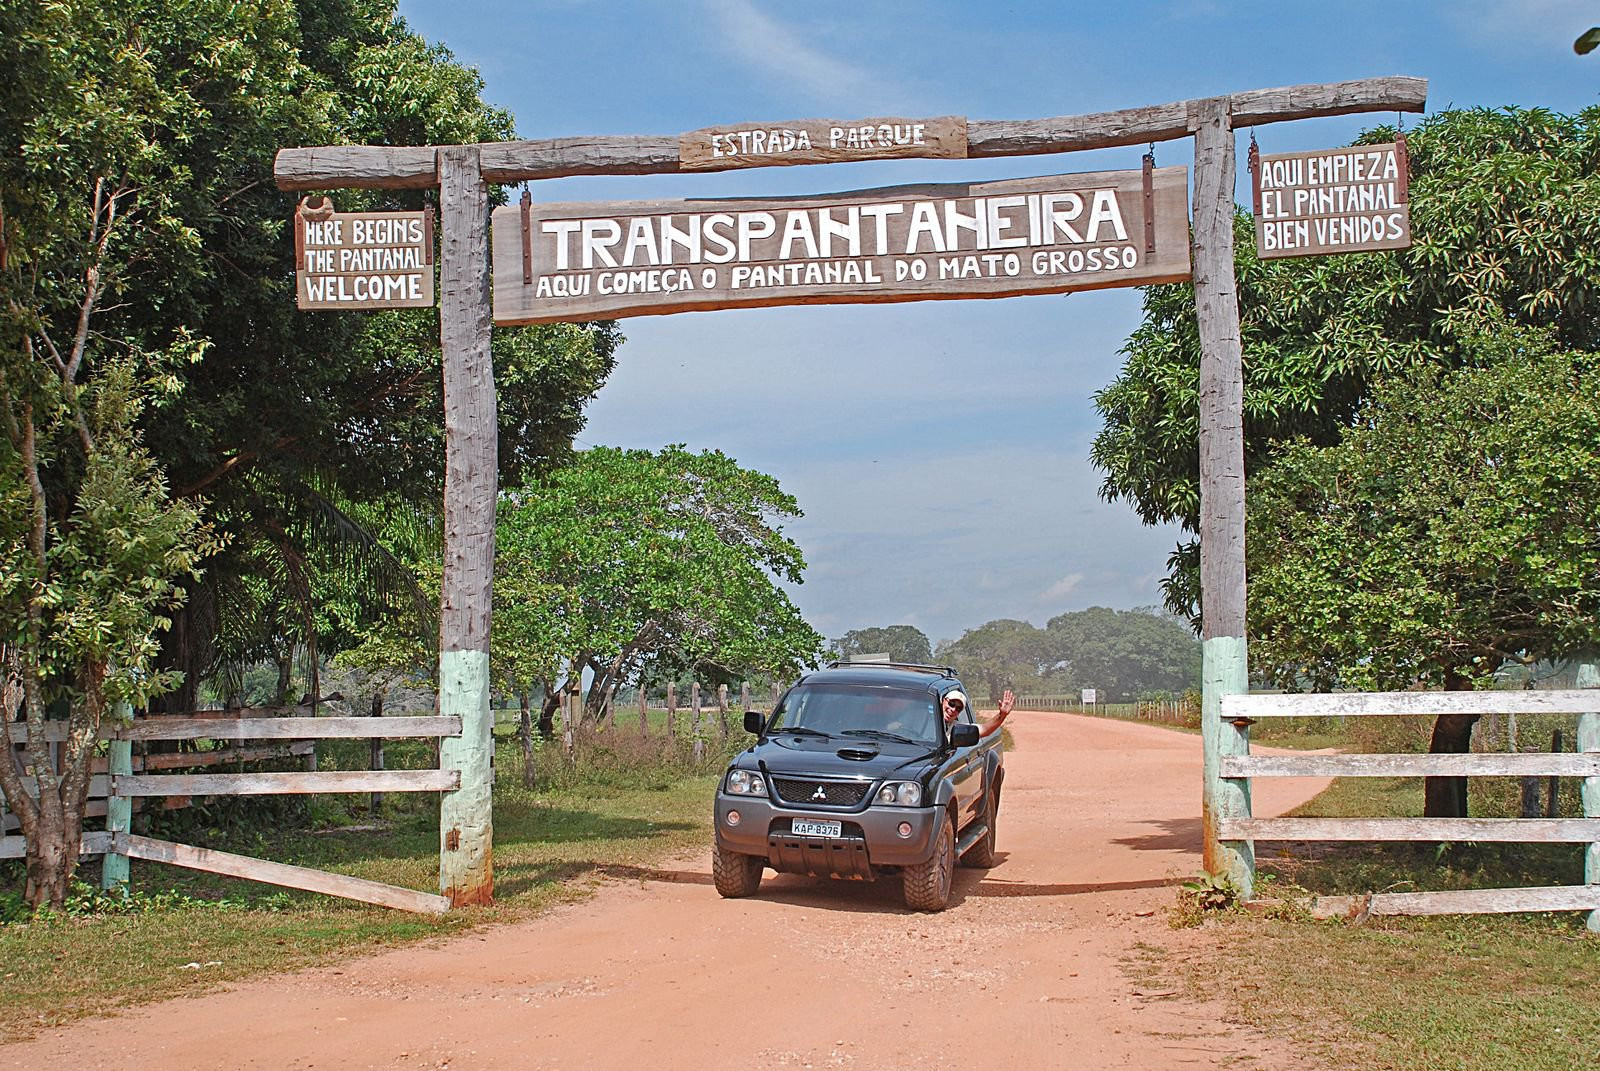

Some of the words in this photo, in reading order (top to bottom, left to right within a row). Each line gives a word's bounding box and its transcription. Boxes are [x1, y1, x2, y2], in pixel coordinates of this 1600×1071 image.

[711, 129, 812, 158] ESTRADA
[830, 123, 926, 149] PARQUE
[1261, 159, 1302, 188] AQUI
[1307, 151, 1398, 184] EMPIEZA
[1262, 190, 1290, 219] EL
[1295, 183, 1401, 216] PANTANAL
[305, 220, 343, 245] HERE
[352, 219, 423, 244] BEGINS
[541, 189, 1129, 271] TRANSPANTANEIRA
[1263, 219, 1310, 250] BIEN
[1314, 213, 1404, 246] VENIDOS
[305, 249, 335, 273] THE
[340, 247, 424, 271] PANTANAL
[535, 274, 591, 298] AQUI
[597, 268, 695, 296] COMEÇA
[701, 268, 717, 289] O
[731, 258, 882, 290] PANTANAL
[896, 258, 927, 282] DO
[939, 253, 1021, 280] MATO
[1032, 246, 1138, 275] GROSSO
[305, 275, 423, 301] WELCOME
